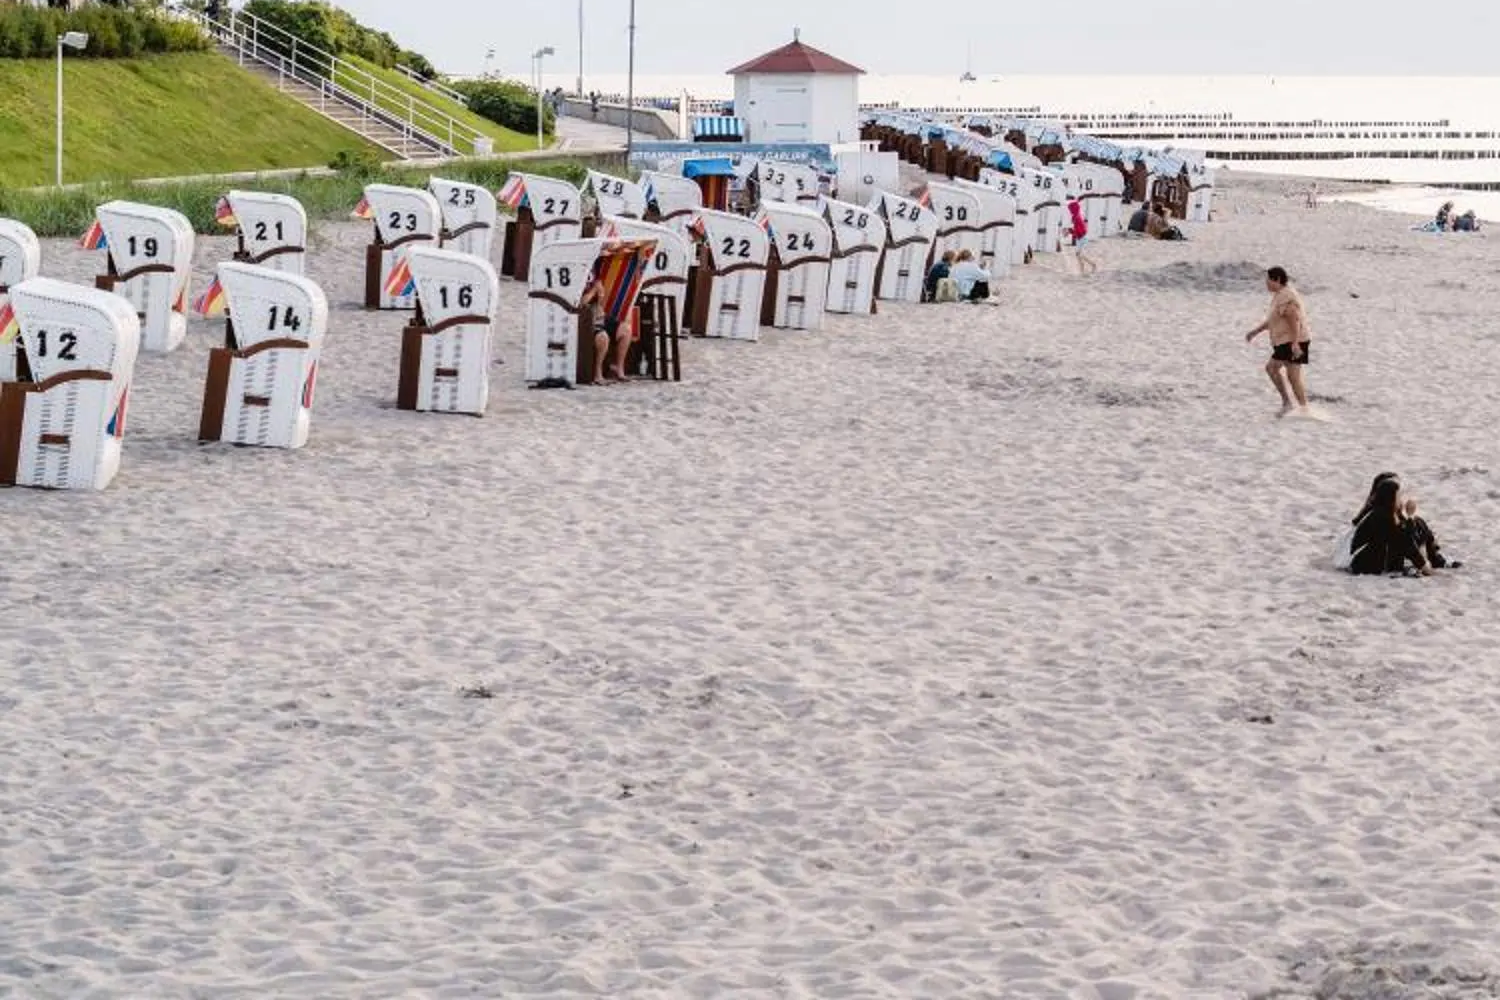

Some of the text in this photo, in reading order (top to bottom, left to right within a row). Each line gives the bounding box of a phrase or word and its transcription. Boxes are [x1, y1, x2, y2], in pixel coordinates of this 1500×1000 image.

[449, 187, 475, 206] 25
[599, 178, 624, 196] 29
[543, 198, 569, 216] 27
[944, 205, 967, 221] 30
[255, 221, 283, 241] 21
[389, 212, 417, 232] 23
[127, 235, 158, 258] 19
[722, 237, 751, 258] 22
[787, 232, 815, 251] 24
[655, 251, 667, 271] 0
[545, 267, 571, 289] 18
[439, 284, 473, 309] 16
[268, 305, 301, 332] 14
[37, 329, 77, 361] 12
